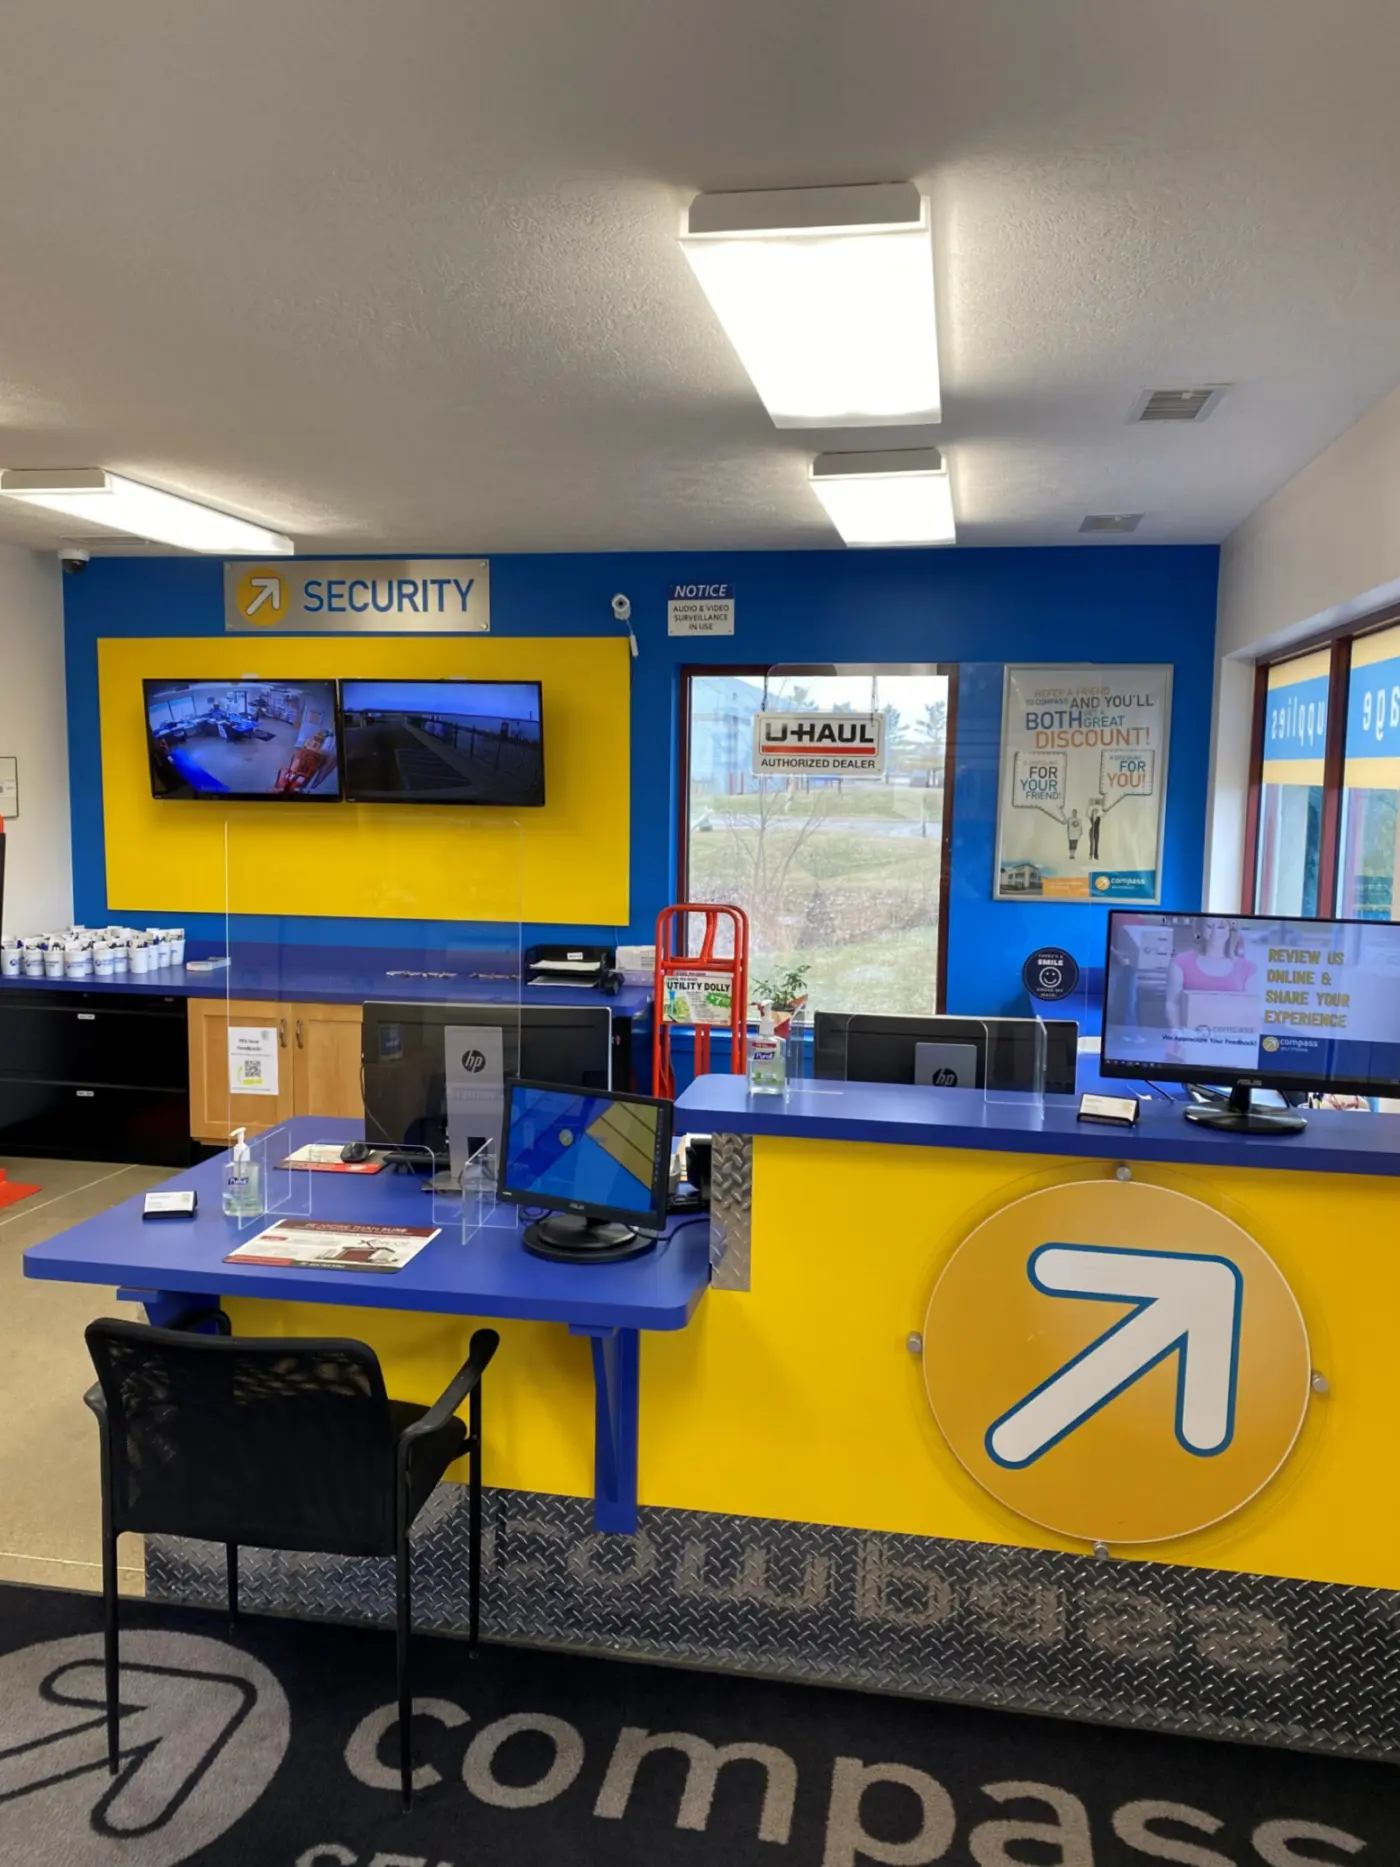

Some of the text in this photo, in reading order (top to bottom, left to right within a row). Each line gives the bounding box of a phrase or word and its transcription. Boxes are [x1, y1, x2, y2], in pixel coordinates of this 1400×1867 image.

[303, 578, 475, 613] SECURITY
[675, 585, 727, 597] NOTICE
[706, 604, 729, 612] VIDEO
[1070, 697, 1101, 709] AND
[1104, 695, 1154, 708] YOU'LL
[1026, 711, 1082, 730] BOTH
[1084, 715, 1125, 728] GREAT
[765, 722, 874, 743] U-HAUL
[1036, 727, 1150, 749] DISCOUNT!
[761, 758, 875, 769] AUTHORIZED DEALER
[1120, 761, 1146, 772] FOR
[1029, 766, 1058, 779] FOR
[1020, 779, 1058, 791] YOUR
[1107, 772, 1146, 788] YOU!
[1026, 791, 1062, 800] FRIEND!
[1111, 878, 1145, 886] compass
[1268, 948, 1344, 965] REVIEW US
[1267, 969, 1331, 986] ONLINE &
[667, 982, 730, 992] UTILITY DOLLY
[1266, 990, 1350, 1007] SHARE YOUR
[1264, 1009, 1347, 1028] EXPERIENCE
[1280, 1039, 1318, 1048] compass
[464, 1050, 484, 1073] hp
